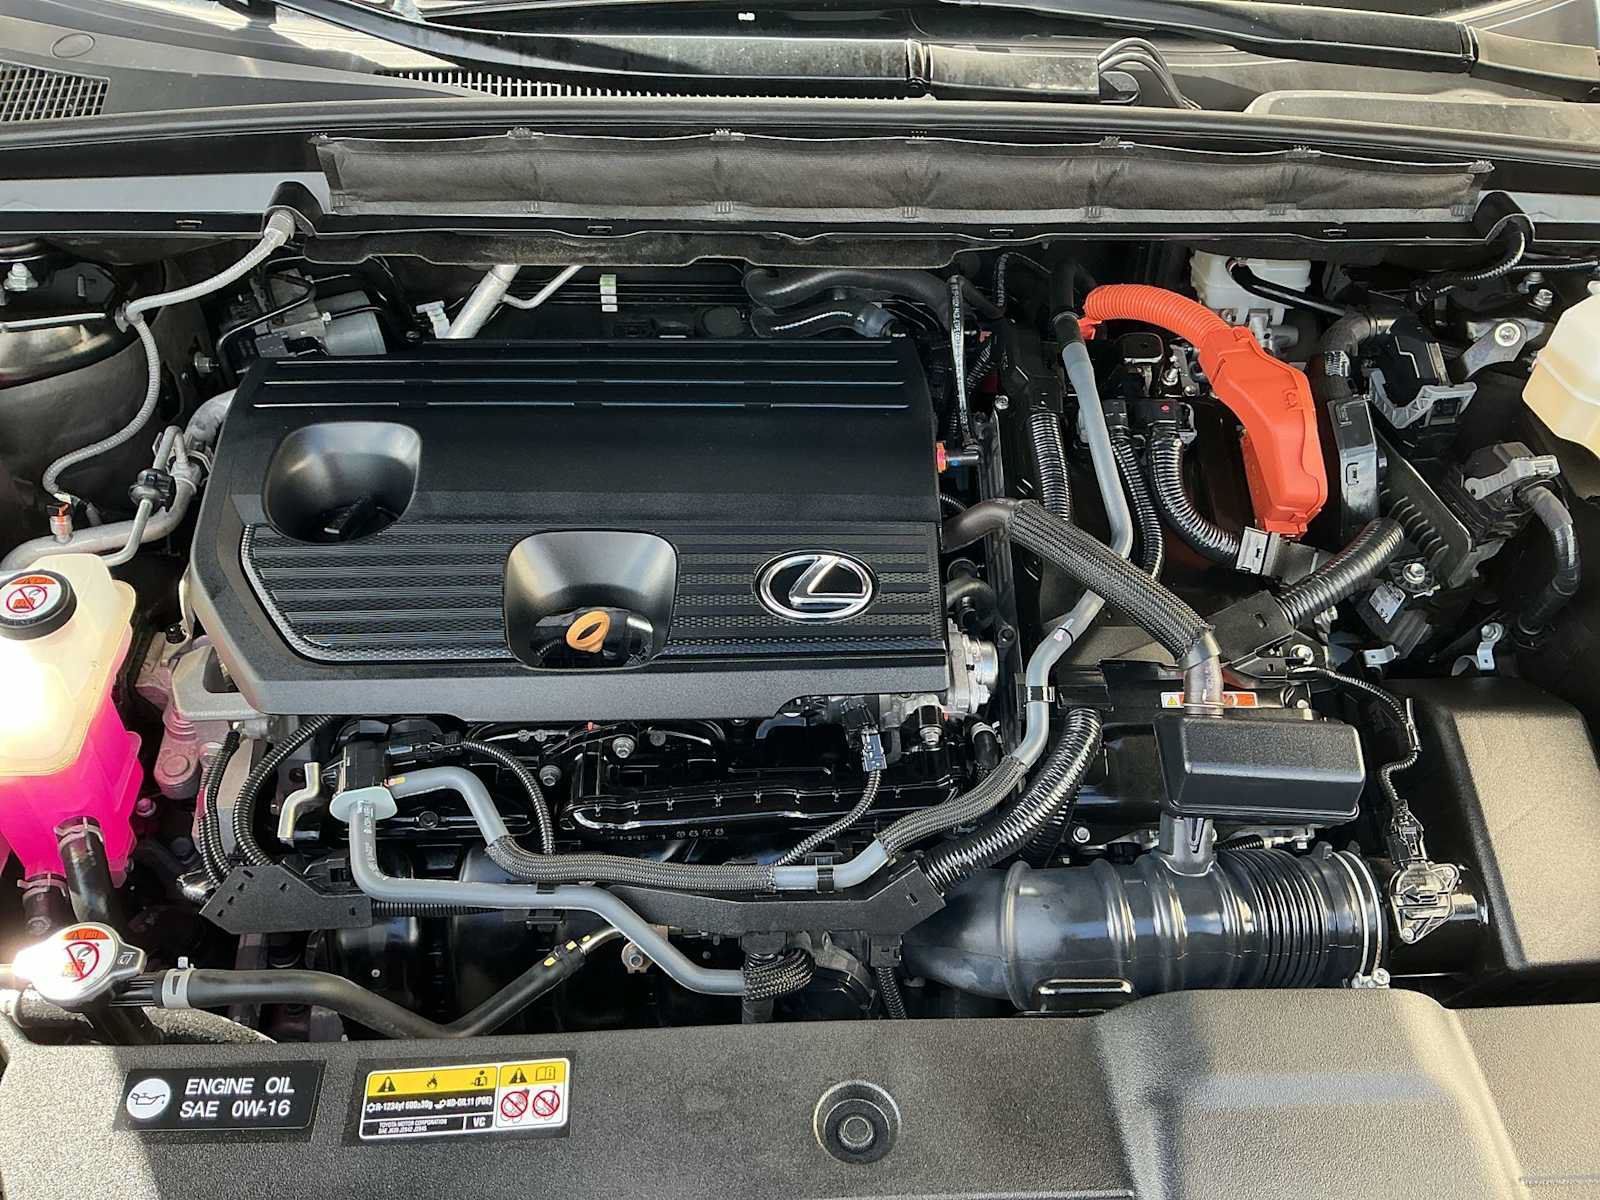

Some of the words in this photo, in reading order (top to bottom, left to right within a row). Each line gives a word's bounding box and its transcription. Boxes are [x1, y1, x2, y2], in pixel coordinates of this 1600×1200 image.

[185, 1077, 255, 1095] ENGINE
[265, 1076, 295, 1094] OIL
[179, 1100, 219, 1117] SAE
[232, 1099, 290, 1117] 0W-16
[473, 1117, 486, 1128] VC
